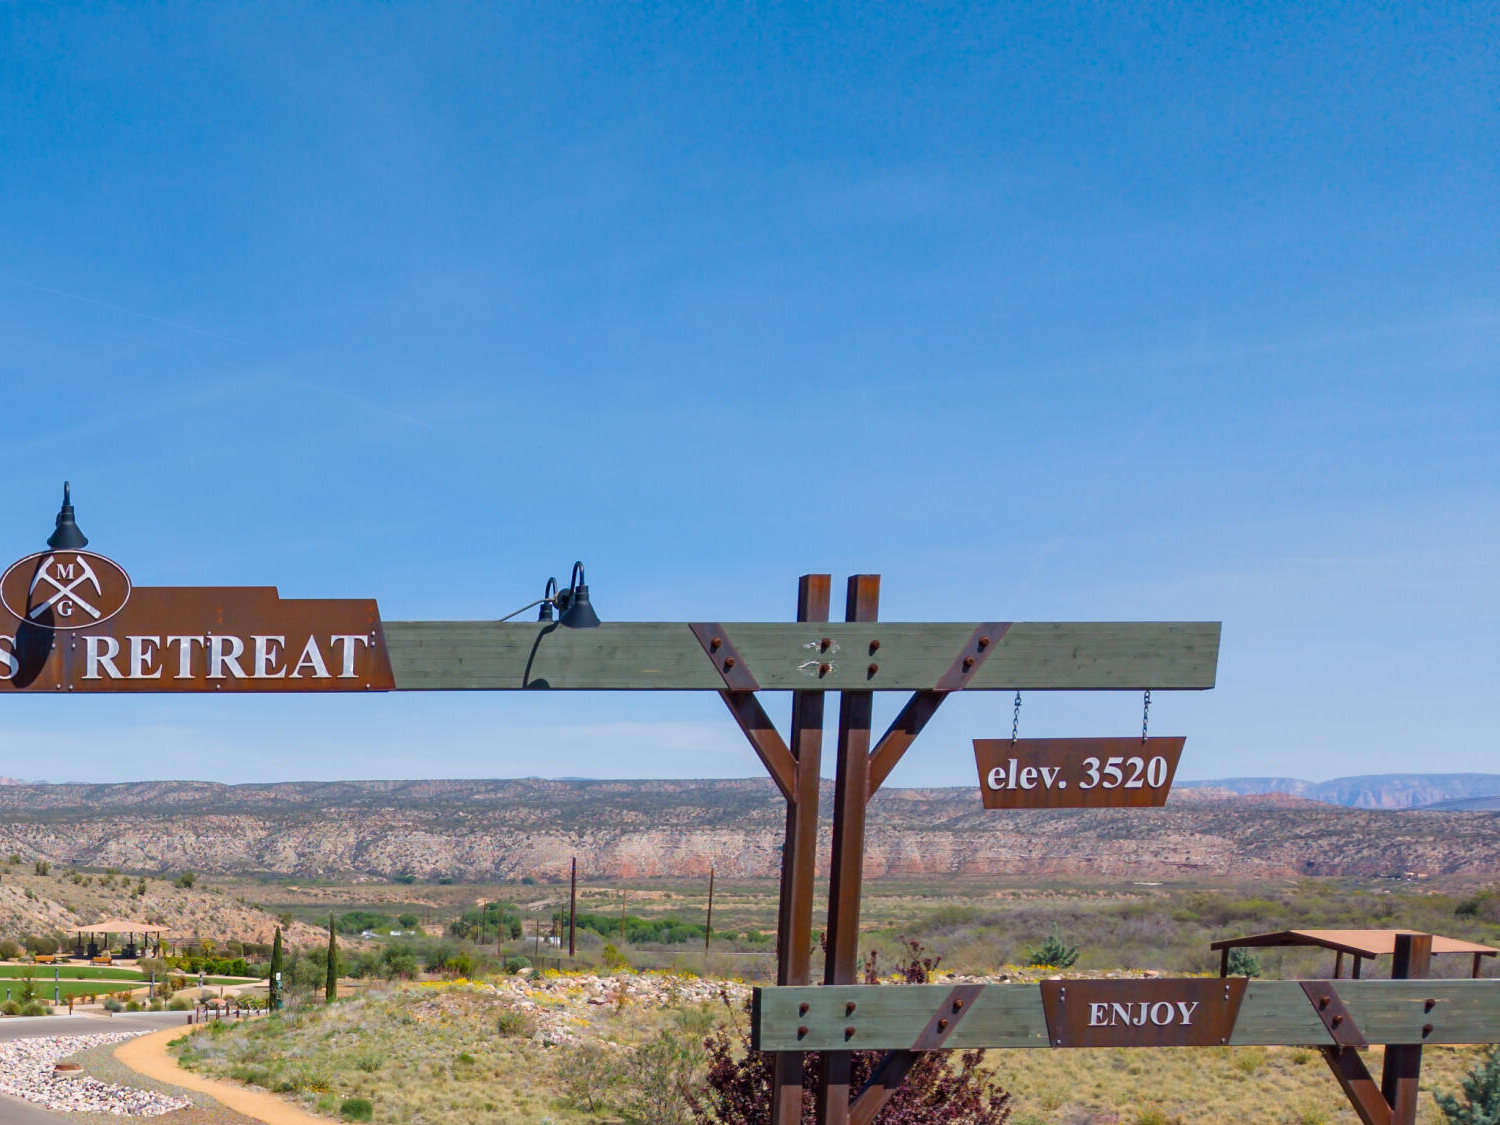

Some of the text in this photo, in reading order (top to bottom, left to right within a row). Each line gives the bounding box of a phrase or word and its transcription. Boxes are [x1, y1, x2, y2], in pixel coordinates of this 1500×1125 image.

[56, 563, 75, 580] M
[57, 600, 74, 617] G
[81, 634, 369, 680] RETREAT
[987, 755, 1168, 790] elev. 3520
[1087, 1001, 1200, 1027] ENJOY
